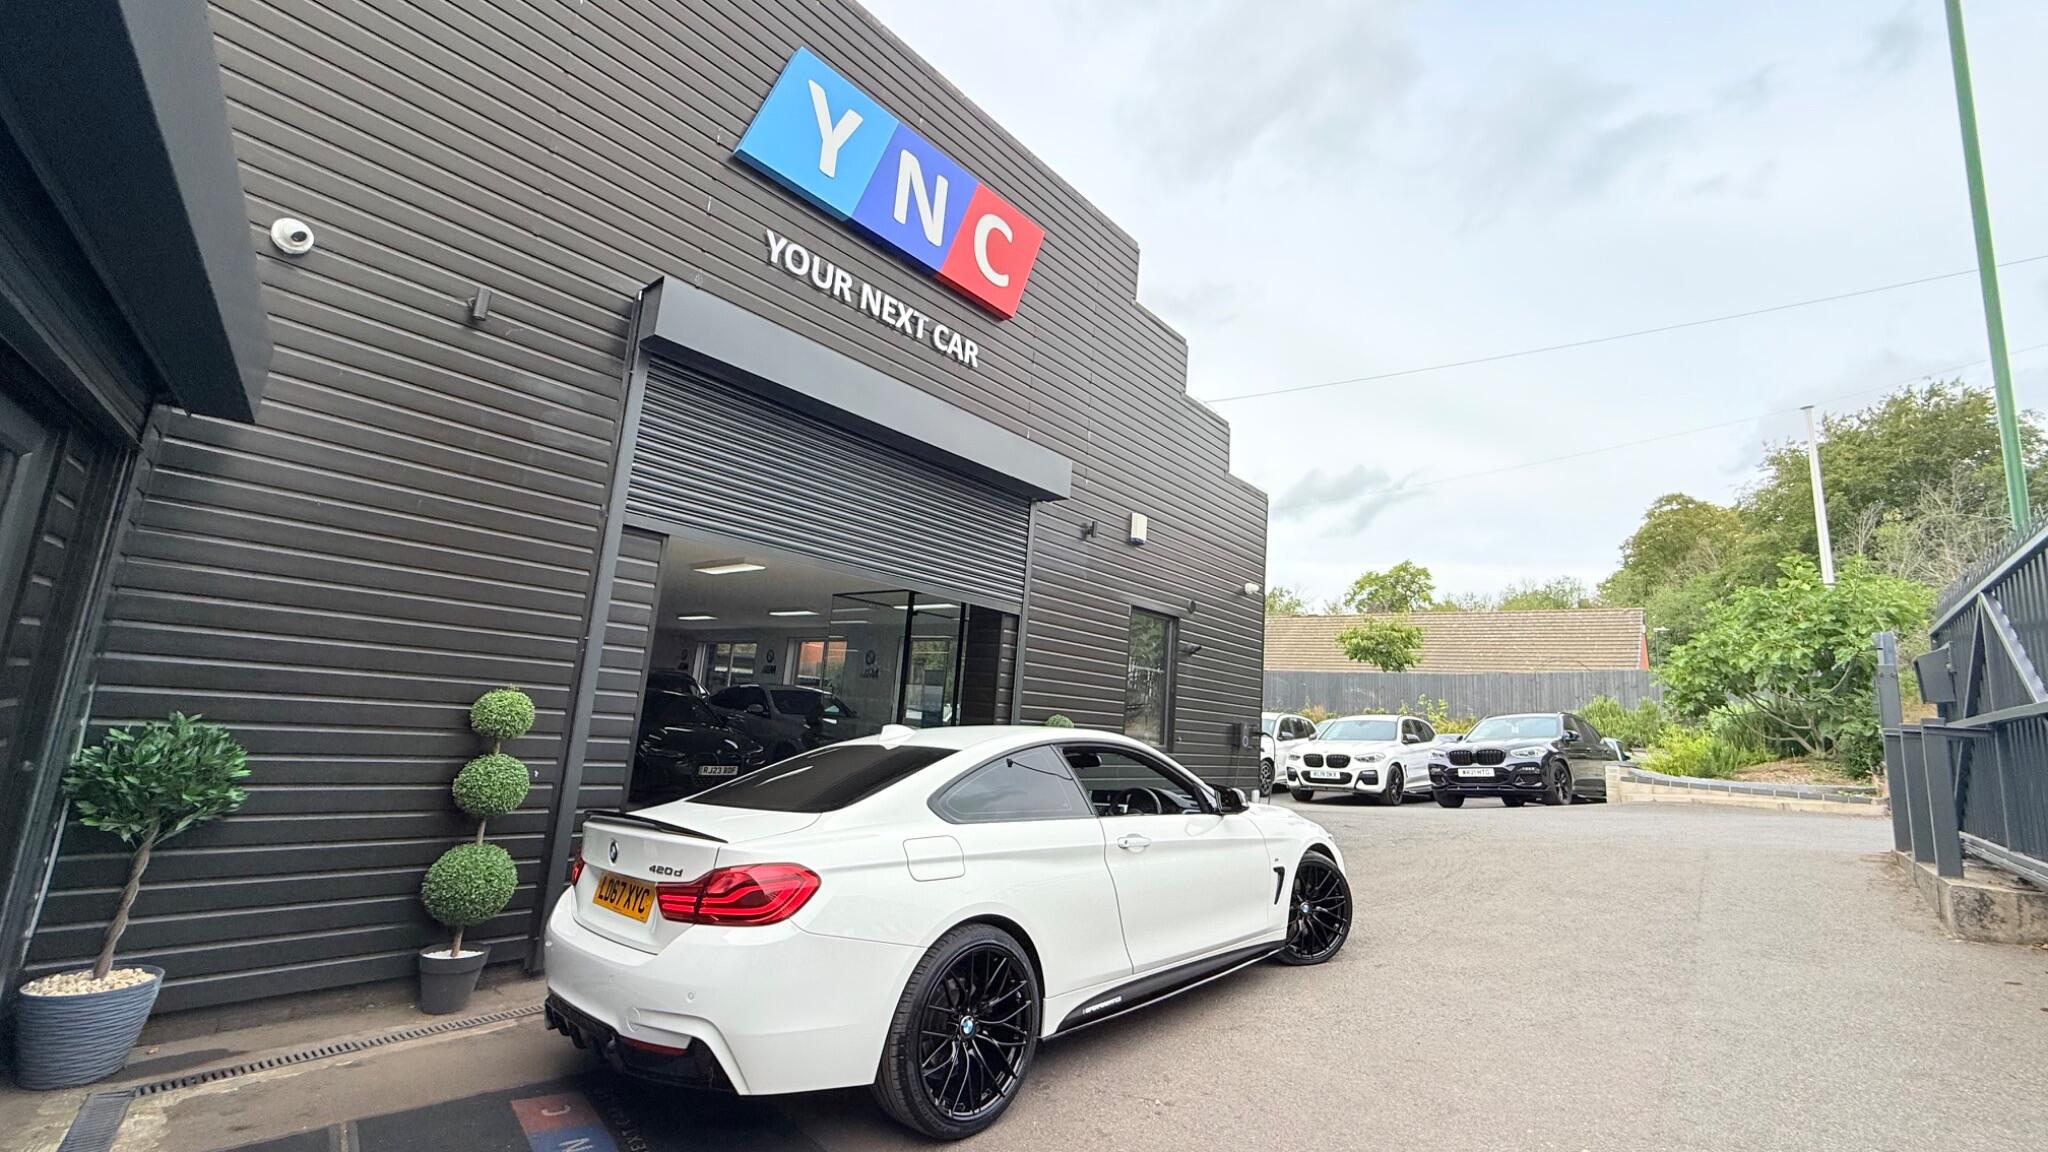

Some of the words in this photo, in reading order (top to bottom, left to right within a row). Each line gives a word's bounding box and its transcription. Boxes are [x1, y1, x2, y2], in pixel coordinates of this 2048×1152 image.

[808, 78, 1013, 288] YNC
[766, 229, 852, 302] YOUR
[860, 282, 930, 340] NEXT
[933, 324, 979, 368] CAR
[598, 876, 626, 905] LD67
[623, 883, 650, 913] XYC
[649, 864, 683, 877] 420d
